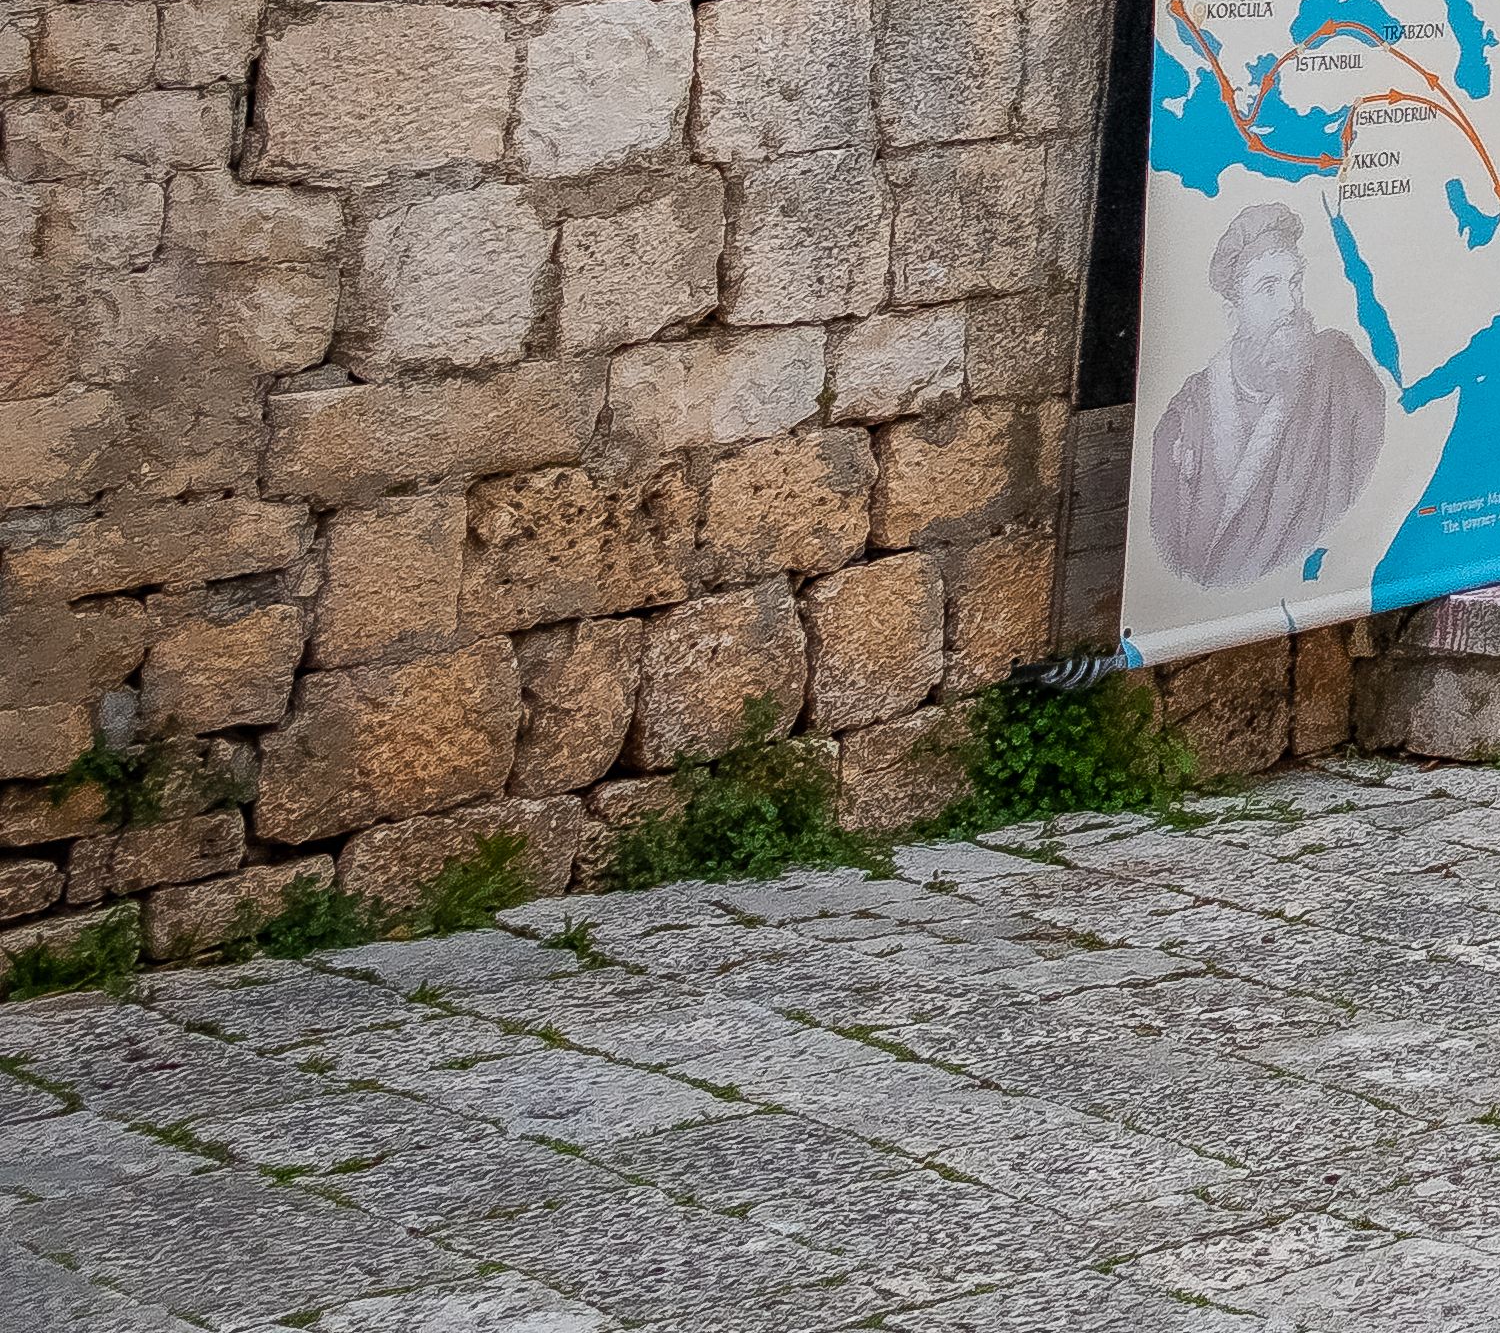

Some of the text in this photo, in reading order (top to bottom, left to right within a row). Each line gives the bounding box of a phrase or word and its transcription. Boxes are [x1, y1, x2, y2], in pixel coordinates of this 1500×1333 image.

[1206, 0, 1274, 19] KORČULA
[1384, 23, 1445, 41] TRABZON
[1296, 54, 1363, 72] ISTANBUL
[1356, 107, 1438, 127] ISKENDERUN
[1351, 151, 1401, 171] AKKON
[1339, 179, 1411, 202] JERUSALEM
